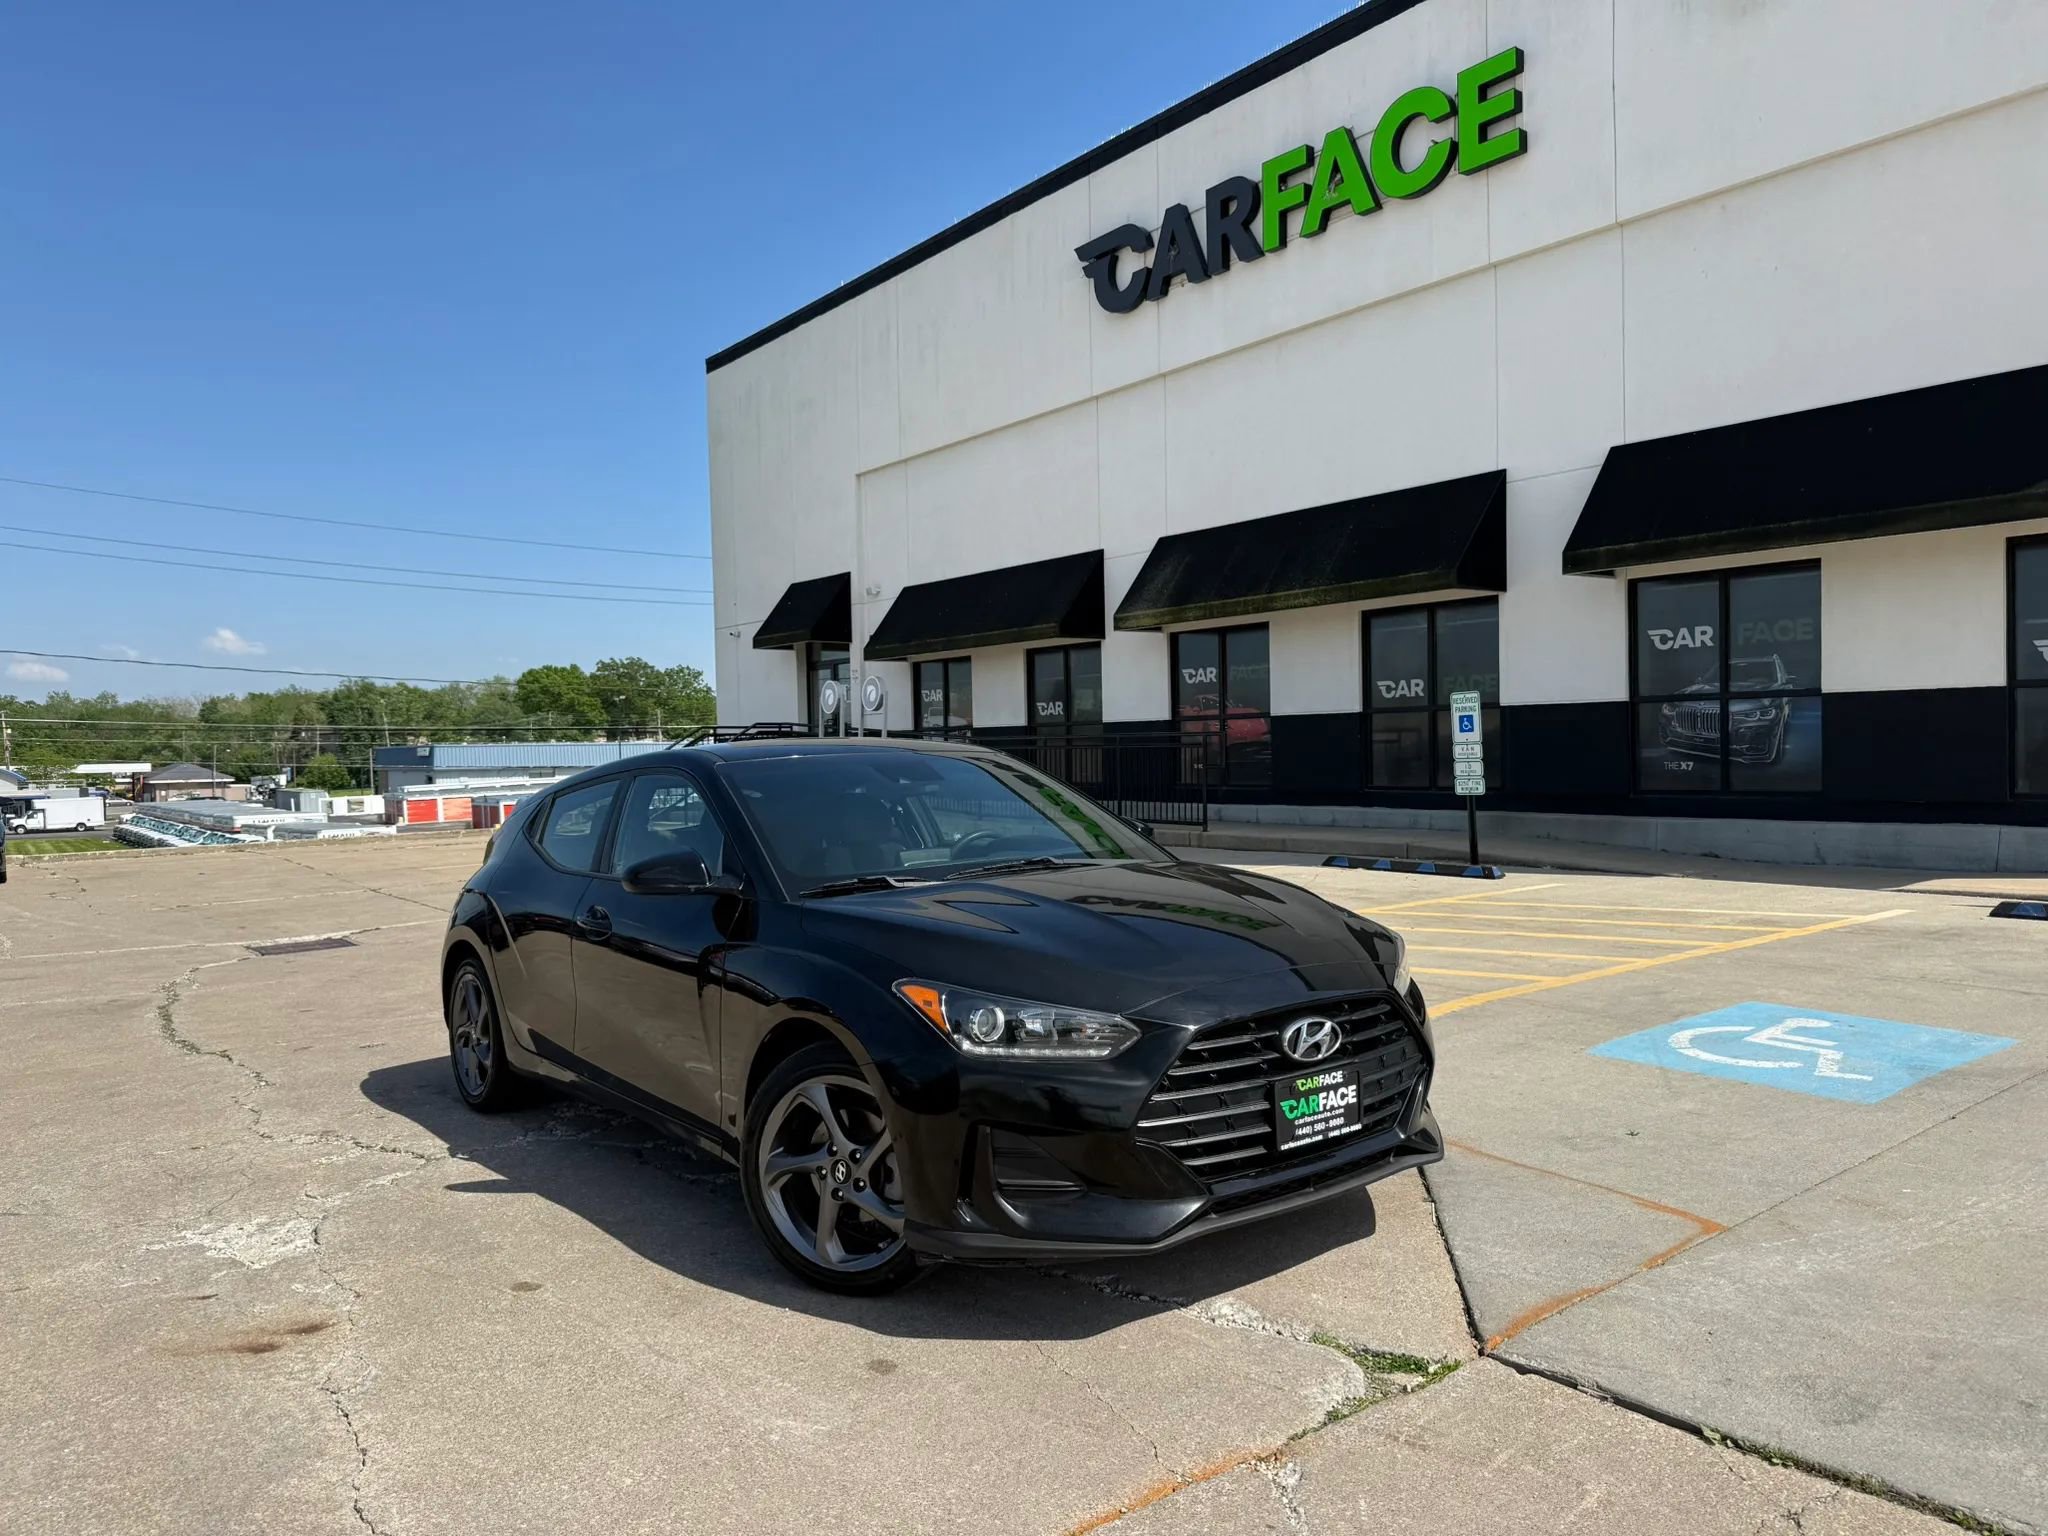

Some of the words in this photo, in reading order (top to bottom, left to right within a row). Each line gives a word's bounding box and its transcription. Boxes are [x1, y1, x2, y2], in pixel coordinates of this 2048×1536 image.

[1074, 46, 1527, 314] CARFACE
[1647, 625, 1715, 650] CAR
[1182, 667, 1217, 684] CAR
[921, 689, 943, 702] CAR
[1376, 678, 1425, 698] CAR
[1036, 701, 1064, 716] CAR
[1664, 762, 1679, 770] THE
[1679, 761, 1694, 771] X7
[1296, 1071, 1344, 1091] CARFACE
[1280, 1085, 1357, 1119] CARFACE
